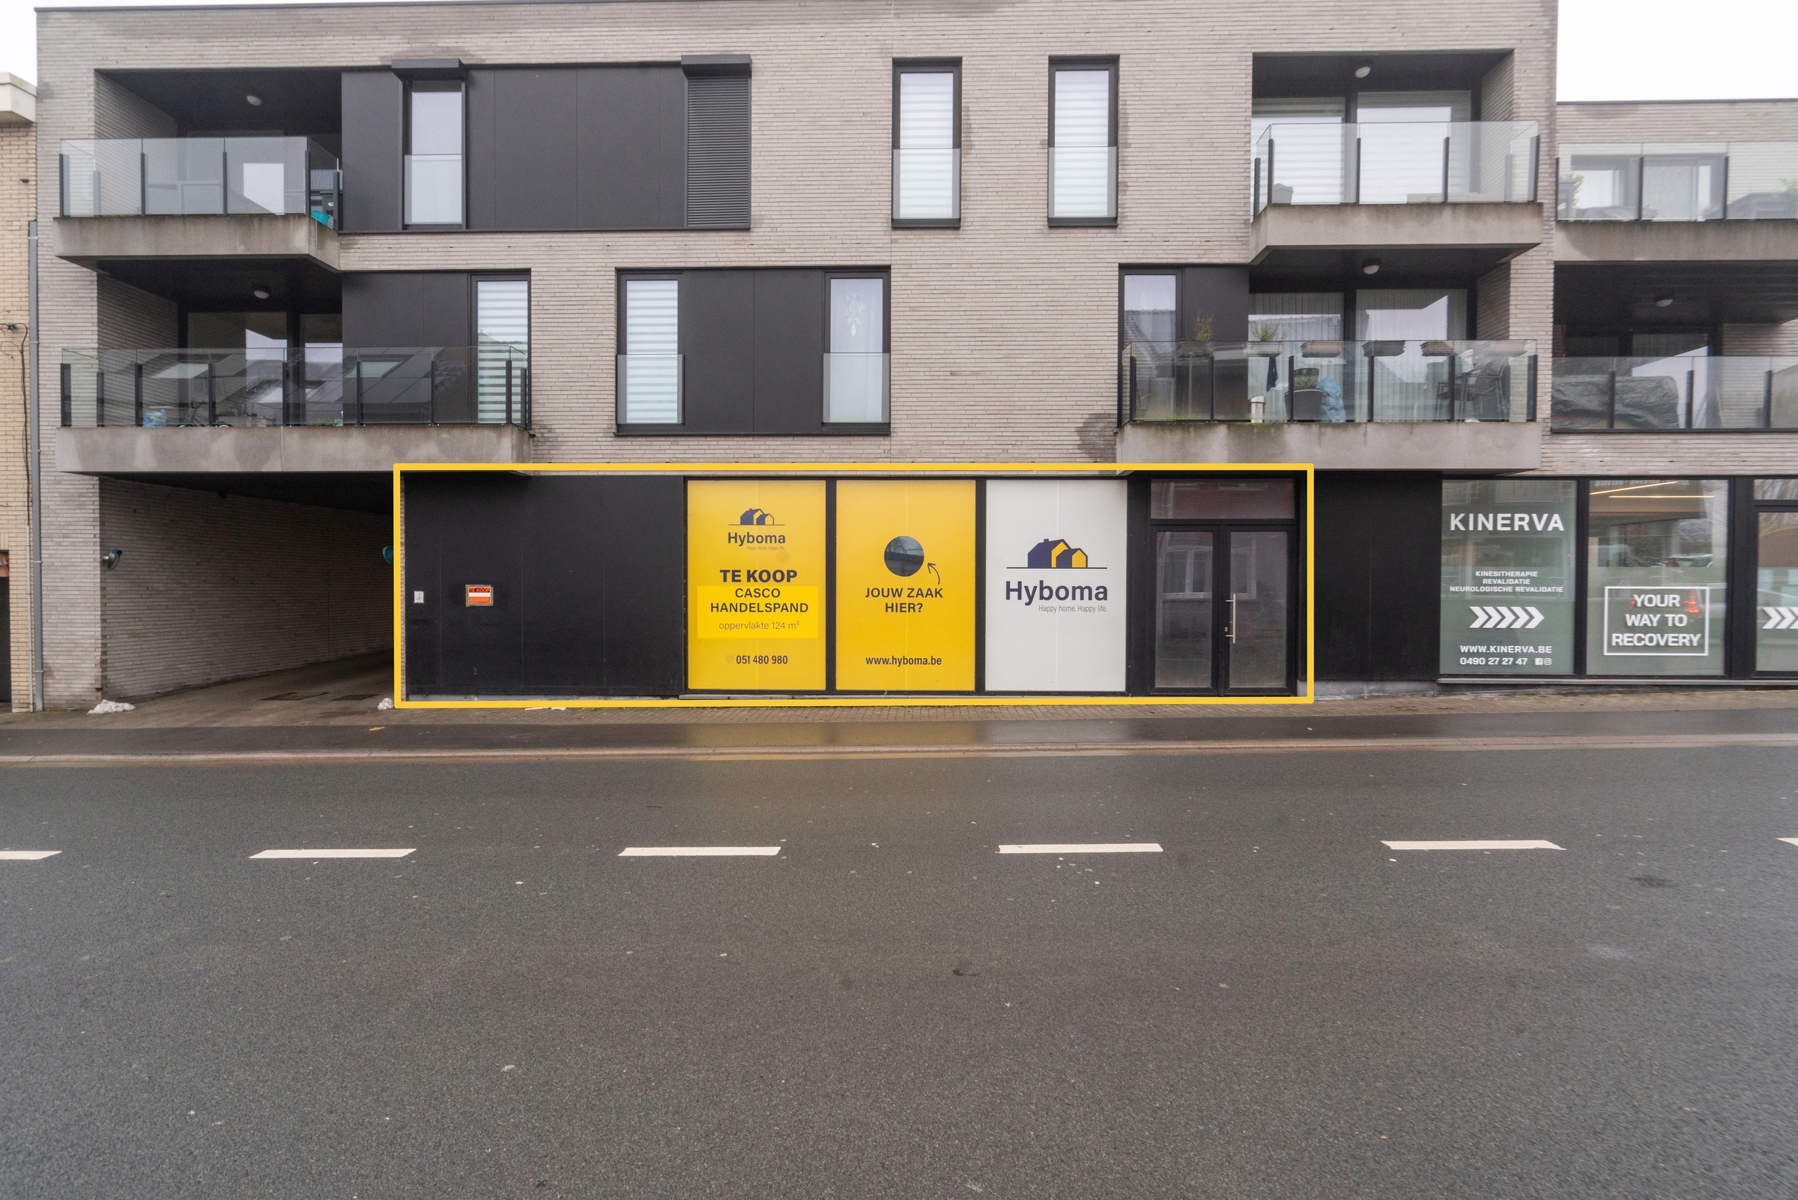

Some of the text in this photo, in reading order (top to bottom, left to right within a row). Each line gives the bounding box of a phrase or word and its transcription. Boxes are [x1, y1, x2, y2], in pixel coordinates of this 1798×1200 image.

[1450, 513, 1564, 531] KINERVA
[728, 532, 785, 546] Hyboma
[720, 570, 797, 583] TE KOOP
[735, 588, 780, 598] CASCO
[865, 588, 943, 598] JOUW ZAAK
[1006, 580, 1108, 606] Hyboma
[1634, 595, 1680, 607] YOUR
[710, 603, 808, 612] HANDELSPAND
[885, 603, 923, 612] HIER?
[719, 621, 800, 630] oppervlakte 124 m²
[1625, 614, 1687, 627] WAY TO
[1612, 634, 1701, 646] RECOVERY
[736, 655, 788, 664] 051 480 980
[865, 656, 942, 667] www.hyboma.be
